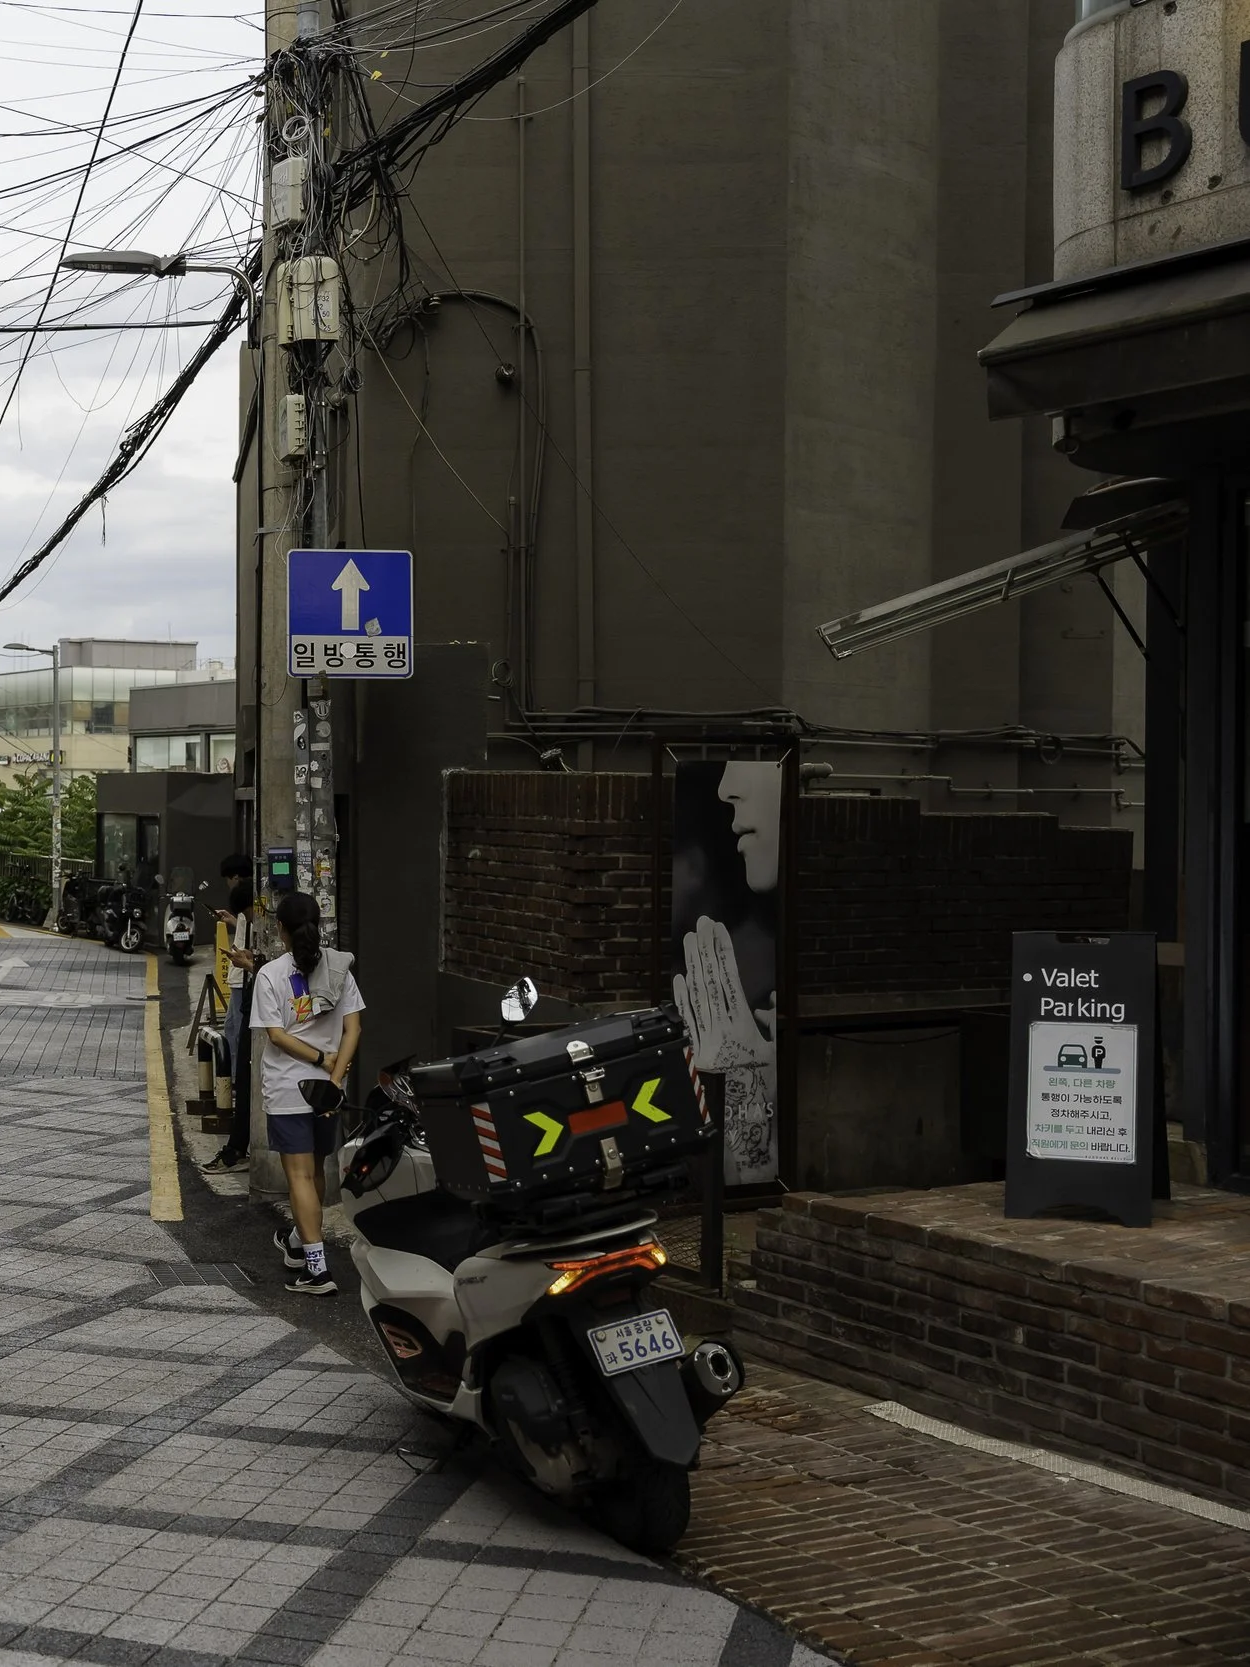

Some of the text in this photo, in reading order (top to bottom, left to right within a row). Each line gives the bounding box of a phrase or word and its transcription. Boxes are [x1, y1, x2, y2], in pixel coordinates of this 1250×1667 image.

[1120, 39, 1250, 190] B
[293, 642, 407, 669] 일방통행
[1041, 967, 1099, 988] Valet
[1040, 997, 1125, 1023] Parking
[1073, 1078, 1093, 1089] 다른
[1095, 1079, 1116, 1089] 차량
[1041, 1092, 1123, 1105] 통행이 가능하도록
[1050, 1108, 1112, 1121] 정차해주시고,
[1065, 1124, 1084, 1135] 두고
[1086, 1126, 1115, 1137] 내리신
[1117, 1127, 1128, 1137] 후
[1070, 1141, 1089, 1151] 문의
[1090, 1142, 1130, 1153] 바랍니다.
[615, 1325, 633, 1339] 서울
[604, 1330, 675, 1365] 파 5646
